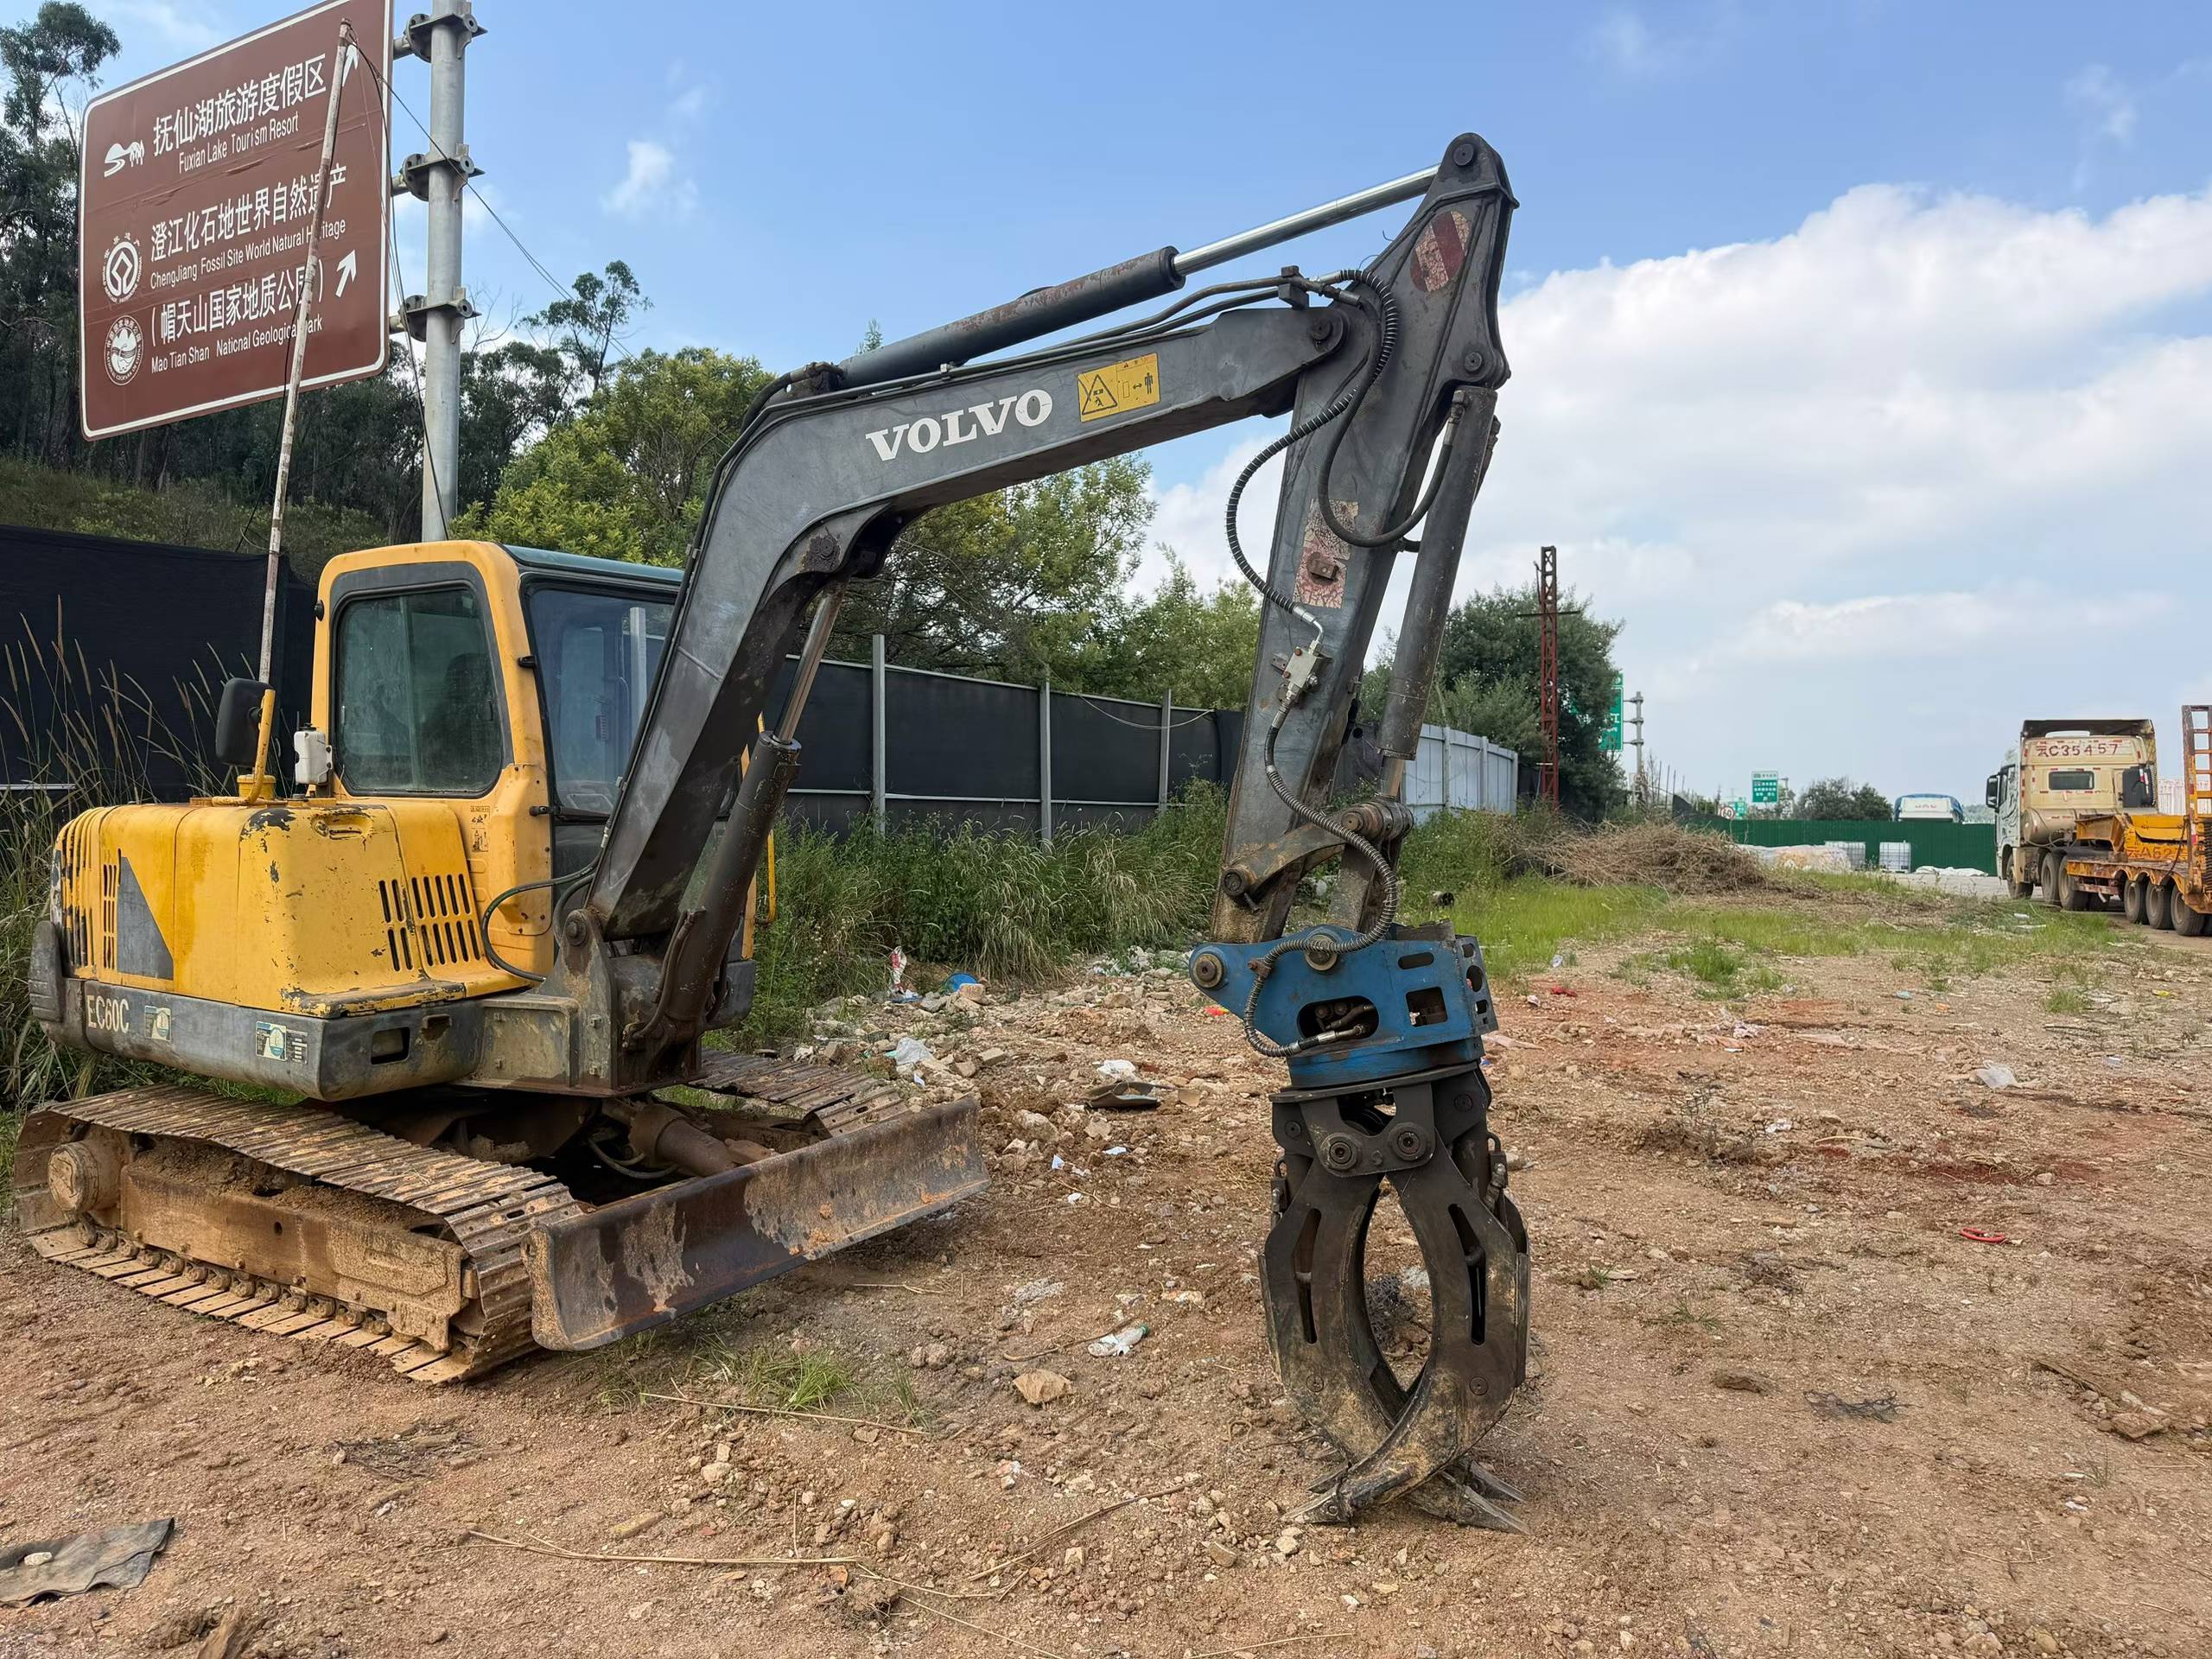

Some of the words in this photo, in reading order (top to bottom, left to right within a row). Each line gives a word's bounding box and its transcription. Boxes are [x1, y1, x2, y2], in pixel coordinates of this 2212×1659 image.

[153, 54, 327, 157] 抚仙湖旅游度假区
[179, 149, 206, 174] Fuxian
[207, 139, 227, 162] Lake
[232, 126, 268, 153] Tourism
[270, 111, 299, 140] Resort
[150, 264, 198, 289] ChengJiang
[200, 253, 226, 274] Fossil
[227, 248, 244, 268] Site
[245, 238, 270, 261] World
[272, 228, 304, 253] Natural
[306, 218, 346, 245] Hitage
[151, 354, 168, 374] Mao
[169, 351, 188, 369] Tian
[188, 346, 210, 364] Shan
[308, 313, 323, 334] ark
[866, 389, 1053, 462] VOLVO
[2036, 743, 2119, 758] 云C35457
[86, 995, 130, 1034] EC60C
